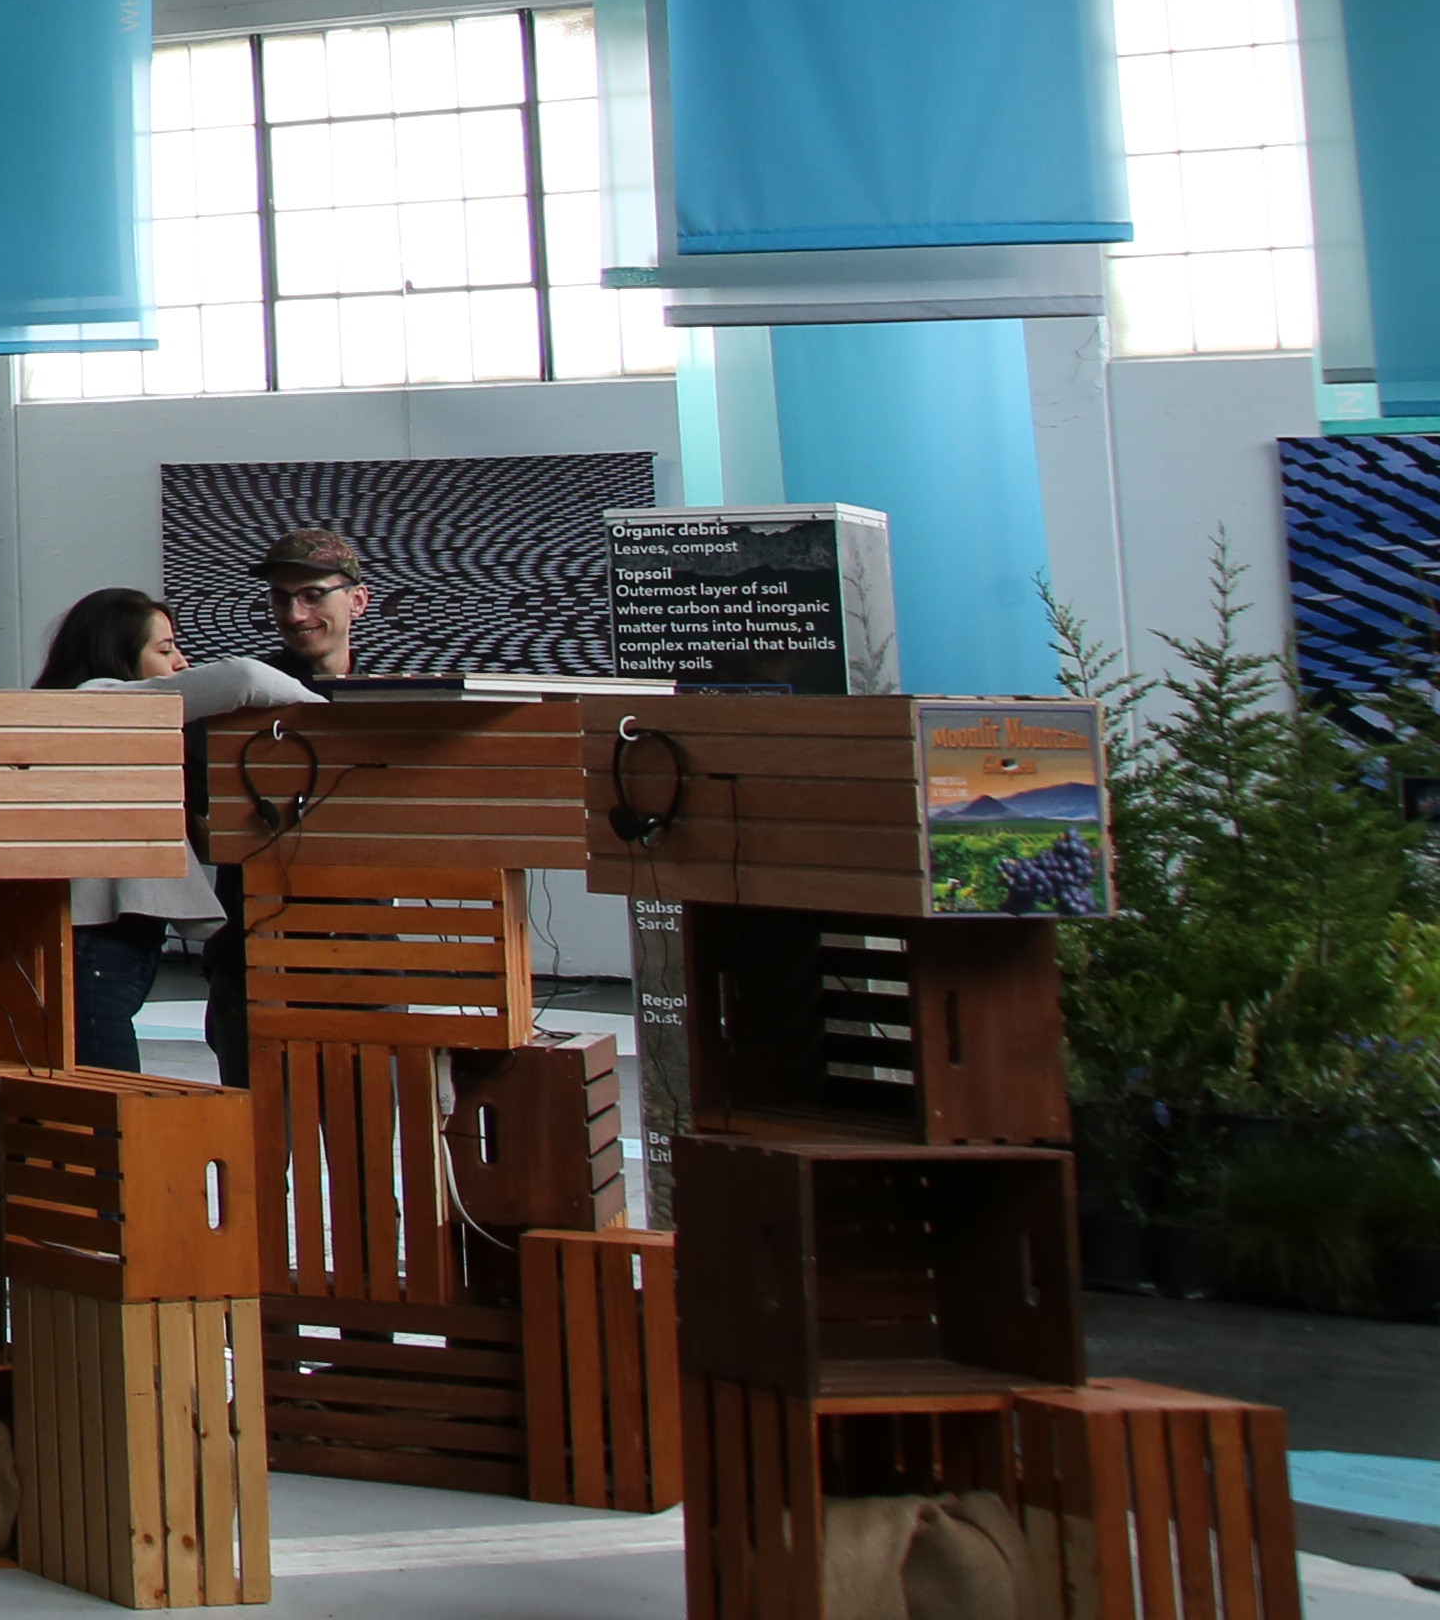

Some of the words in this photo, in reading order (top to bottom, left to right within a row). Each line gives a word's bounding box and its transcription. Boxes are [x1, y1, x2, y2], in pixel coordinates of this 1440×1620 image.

[612, 524, 675, 541] Organic
[678, 522, 729, 537] debris
[614, 542, 669, 556] Leaves,
[673, 540, 738, 556] compost
[615, 567, 672, 583] Topsoil
[616, 583, 697, 598] Outermost
[700, 583, 737, 600] layer
[741, 581, 757, 596] of
[761, 582, 787, 595] soil
[617, 602, 663, 615] where
[667, 601, 720, 614] carbon
[724, 601, 753, 614] and
[757, 599, 830, 617] inorganic
[618, 621, 667, 633] matter
[671, 621, 707, 633] turns
[712, 619, 741, 632] into
[746, 619, 802, 635] humus,
[806, 621, 814, 631] a
[619, 639, 684, 655] complex
[687, 637, 750, 651] material
[753, 637, 785, 651] that
[788, 636, 836, 651] builds
[620, 656, 675, 674] healthy
[679, 655, 712, 671] soils
[637, 917, 679, 933] Sand,
